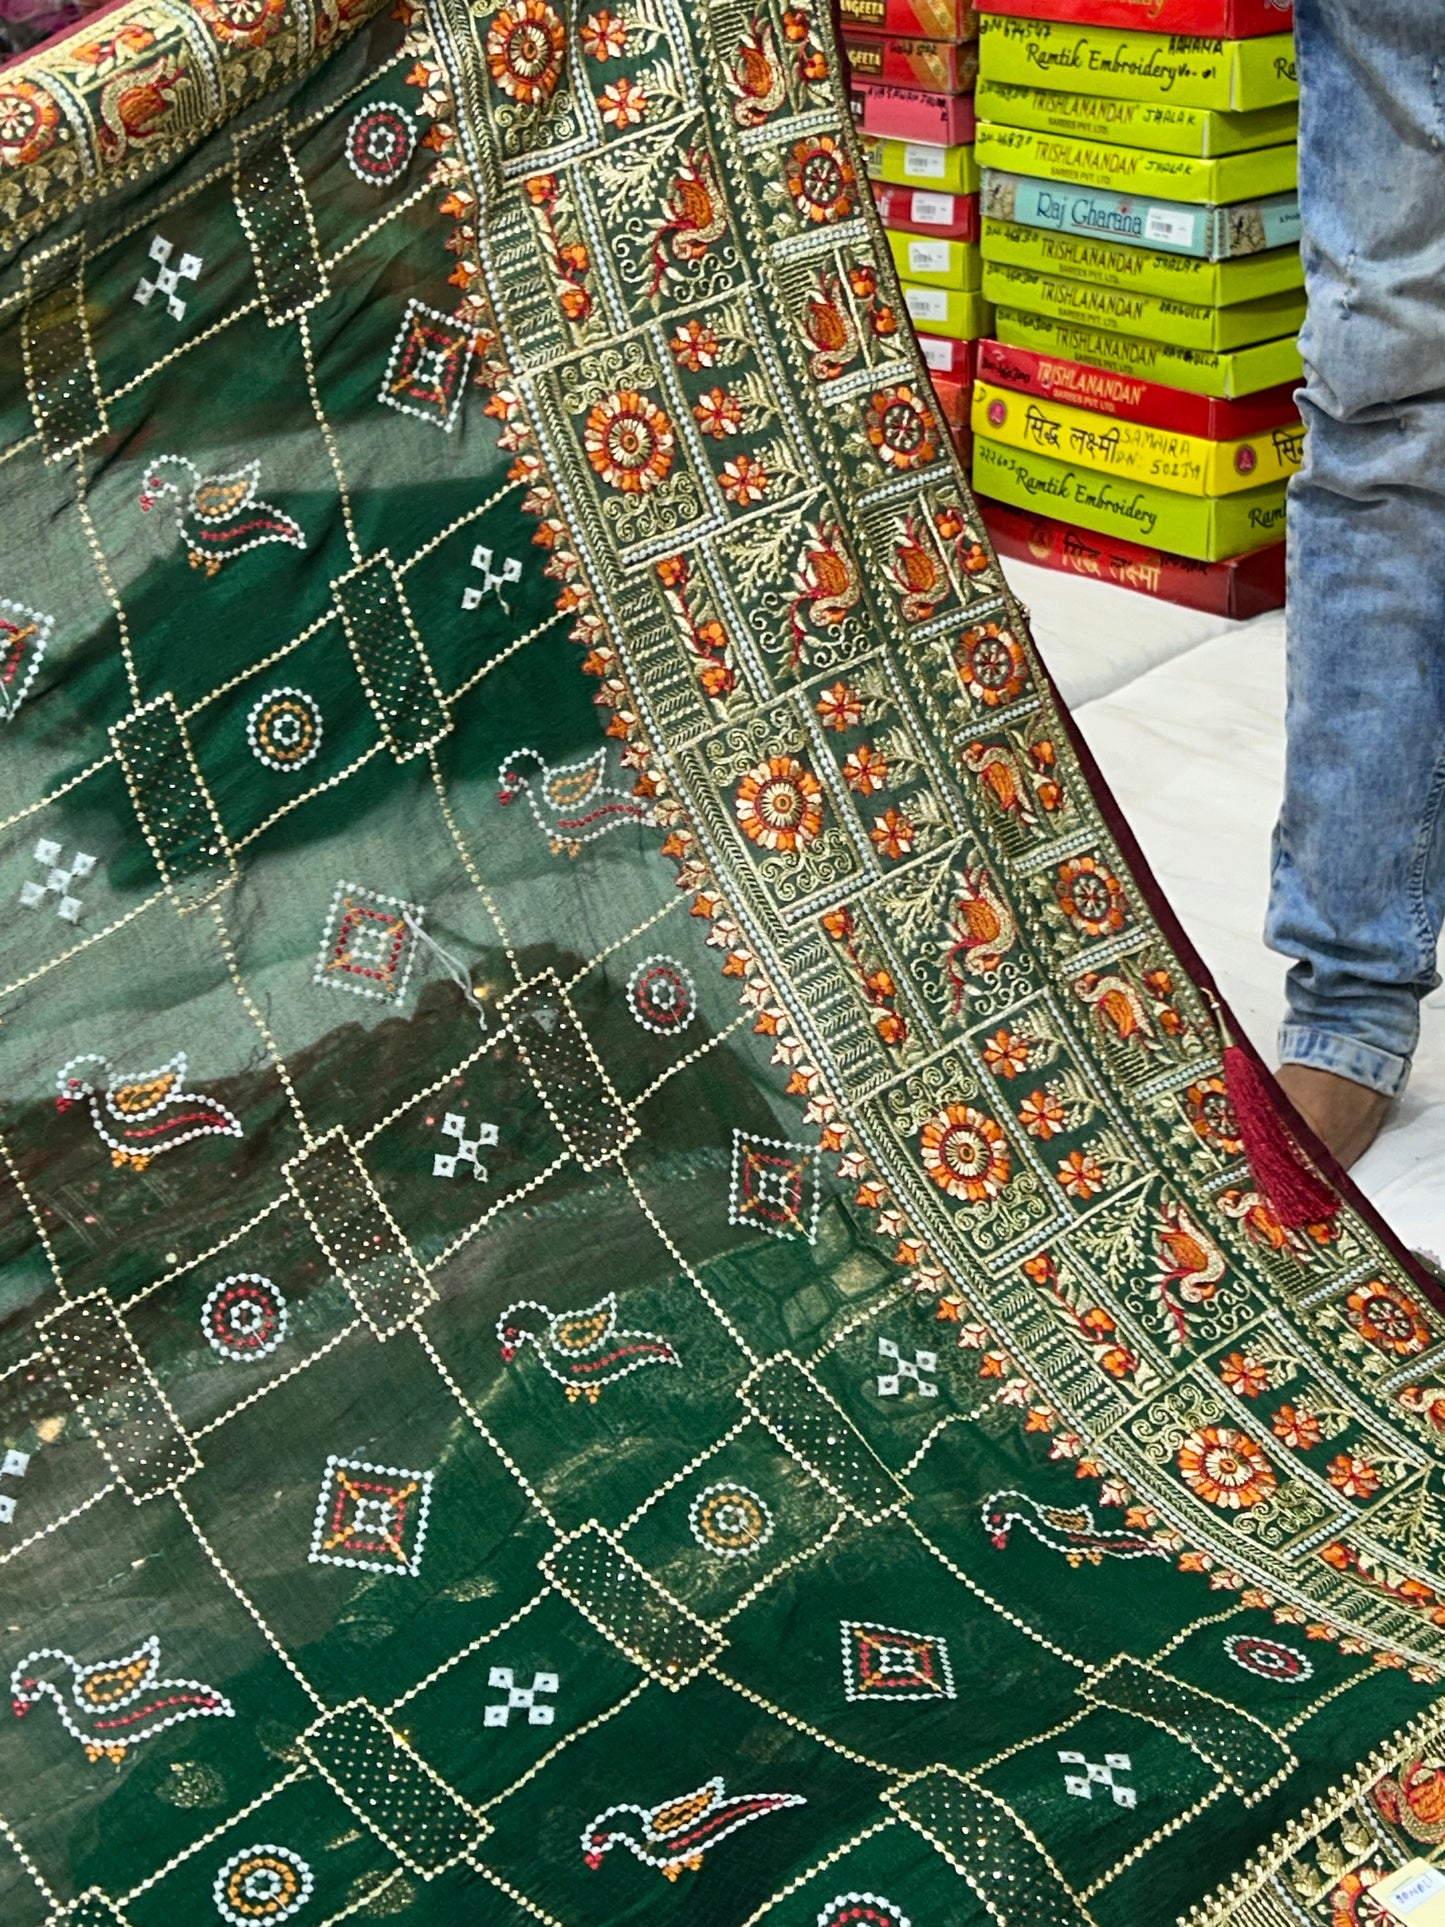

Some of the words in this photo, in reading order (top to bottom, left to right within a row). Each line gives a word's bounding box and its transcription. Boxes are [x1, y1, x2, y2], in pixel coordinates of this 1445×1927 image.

[1026, 38, 1088, 70] Ramtik
[1089, 44, 1177, 92] Embroidery
[1032, 90, 1136, 124] TRISHLANANDAN
[1035, 141, 1137, 175] TRISHLANANDAN
[1036, 191, 1066, 228] Raj
[1071, 199, 1142, 235] Gharana
[1041, 238, 1143, 275] TRISHLANANDAN
[1041, 281, 1143, 319] TRISHLANANDAN
[1056, 326, 1157, 367] TRISHLANANDAN
[1037, 361, 1142, 406] TRISHLANANDAN
[1024, 405, 1062, 450] सिद्ध
[1070, 427, 1120, 463] लक्ष्मी
[1015, 467, 1075, 498] Ramtik
[1074, 484, 1157, 534] Embroidery
